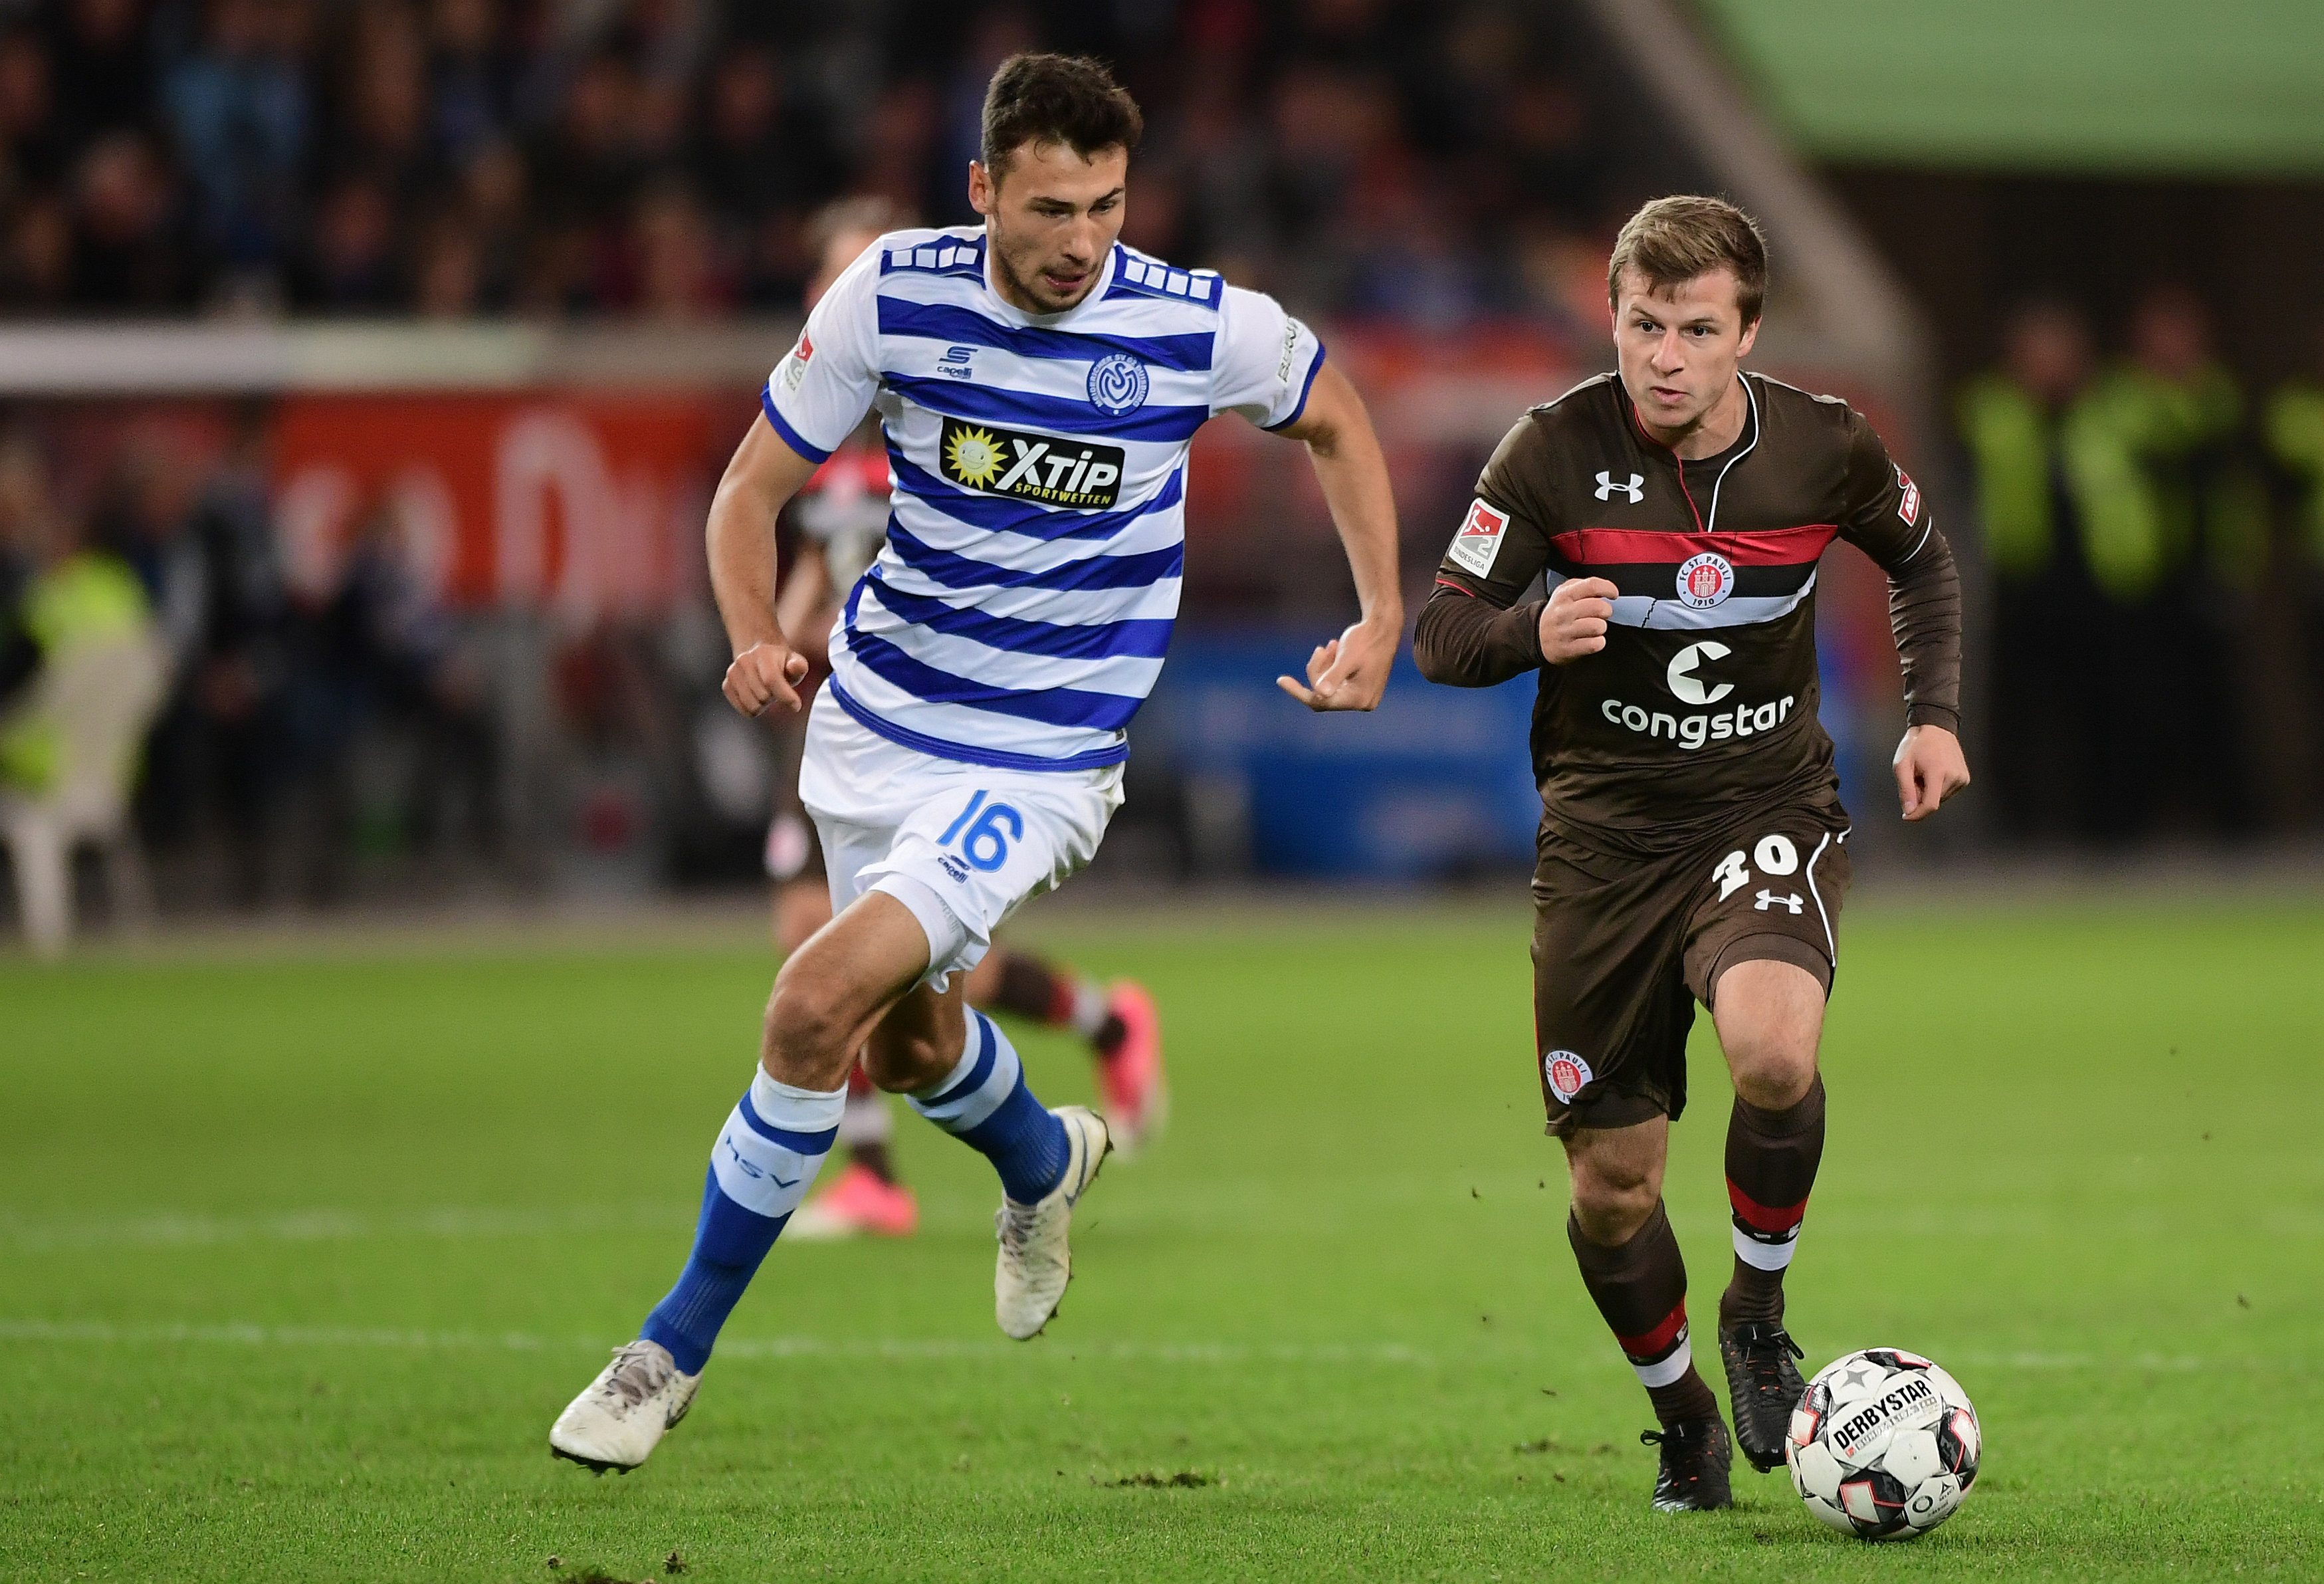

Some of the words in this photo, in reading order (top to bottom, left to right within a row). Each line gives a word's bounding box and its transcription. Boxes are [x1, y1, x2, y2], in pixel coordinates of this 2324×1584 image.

[1014, 482, 1112, 505] SPORTWETTEN
[1679, 570, 1689, 581] FC
[1688, 558, 1703, 569] ST.
[1706, 556, 1731, 580] PAULI
[1692, 598, 1715, 607] 1910
[1602, 696, 1794, 750] congstar
[936, 788, 1024, 873] 16
[1712, 834, 1798, 903] 20
[1558, 1052, 1588, 1074] PAULI
[1833, 1380, 1932, 1450] DERBYSTAR
